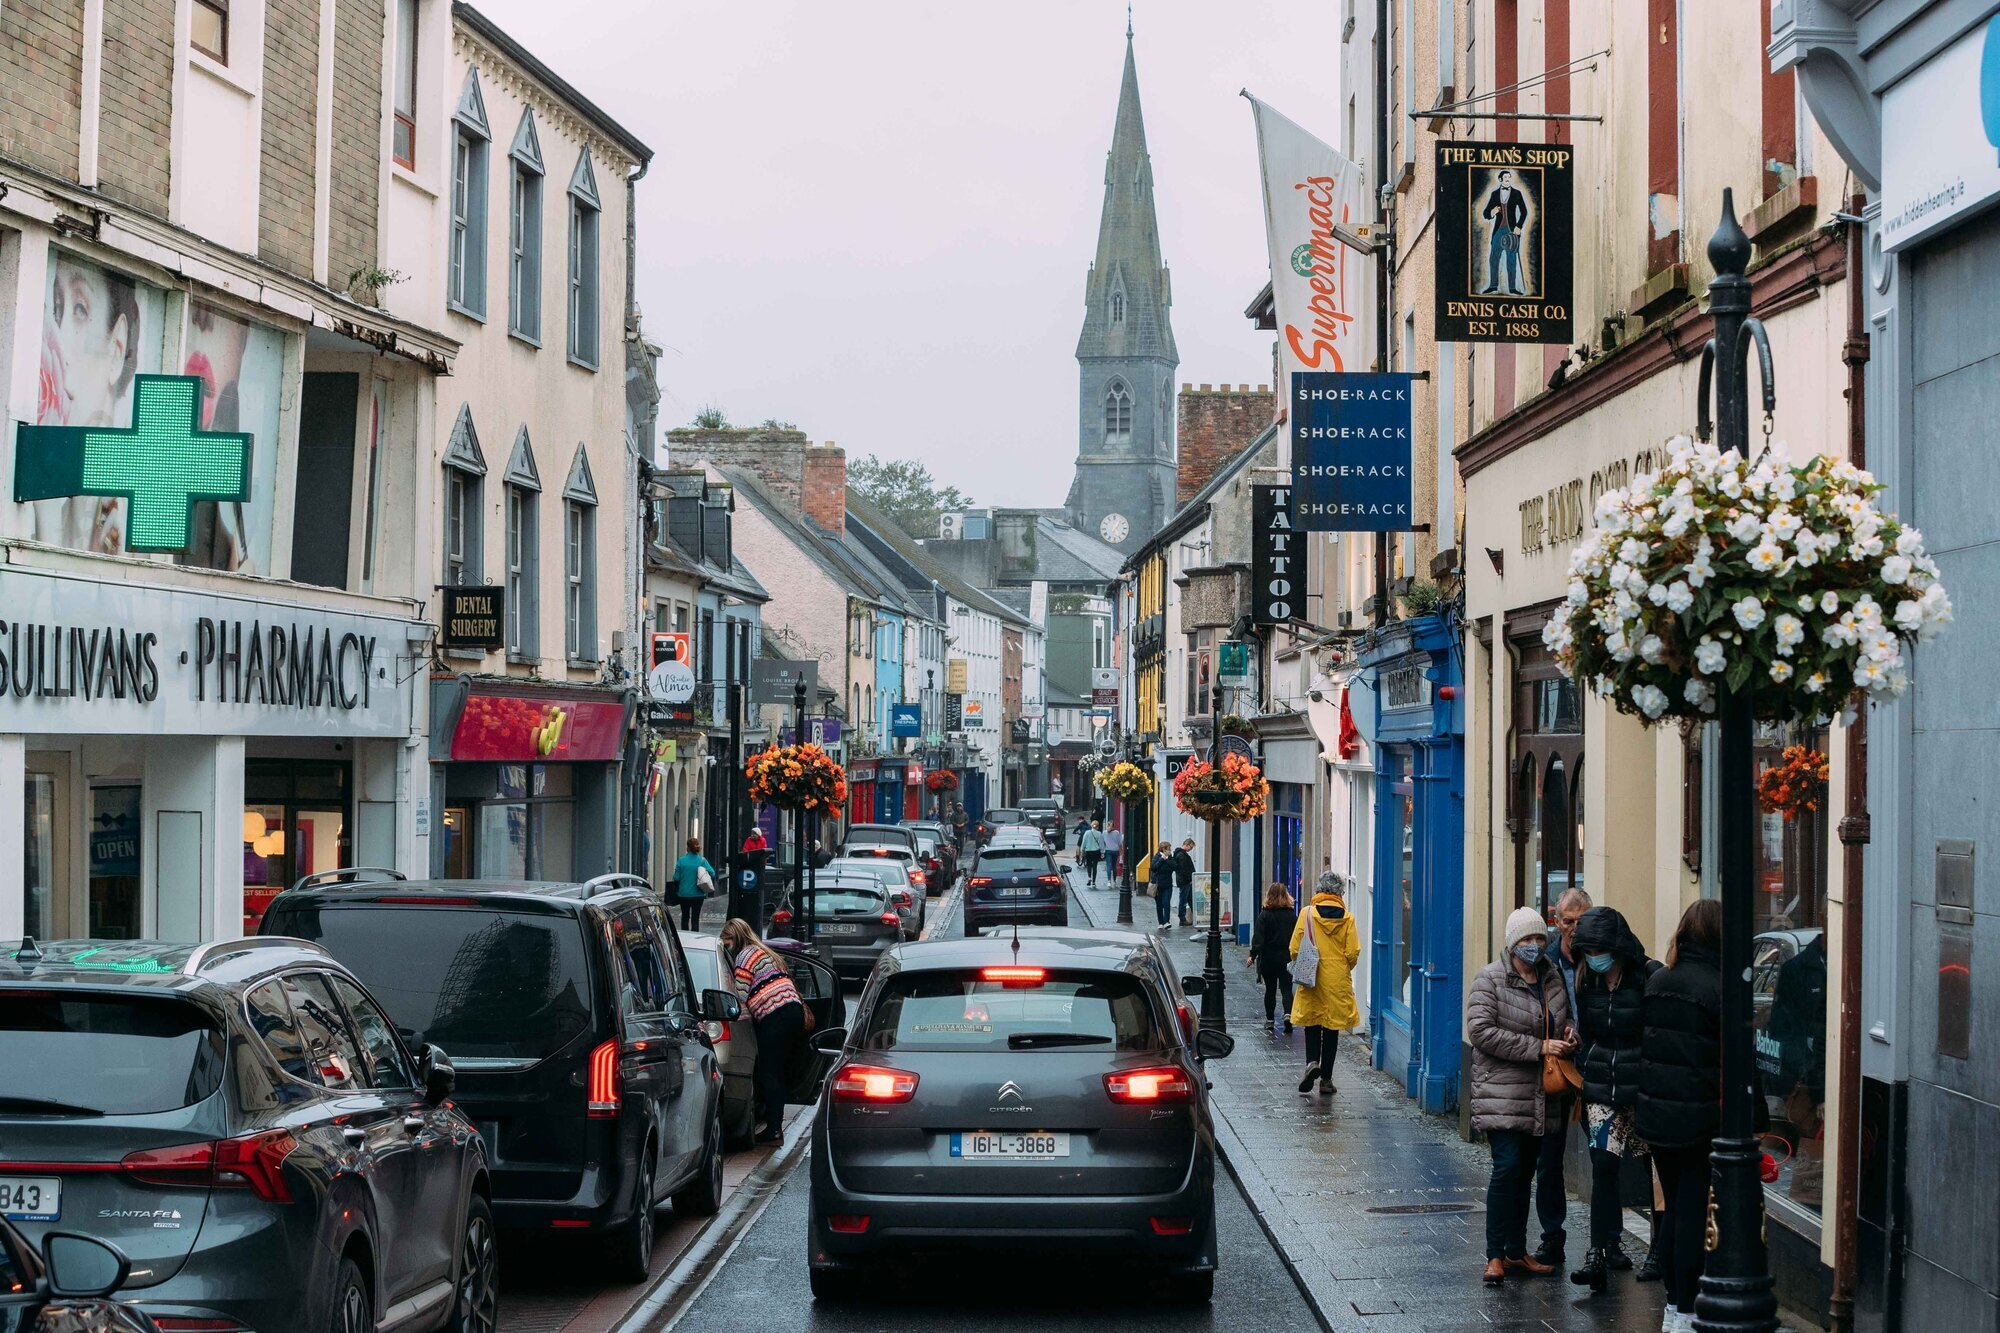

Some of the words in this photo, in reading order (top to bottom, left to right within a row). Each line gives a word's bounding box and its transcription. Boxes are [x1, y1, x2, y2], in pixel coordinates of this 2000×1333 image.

[1441, 148, 1475, 165] THE
[1481, 147, 1522, 164] MAN'S
[1527, 150, 1570, 168] SHOP
[1883, 176, 1965, 235] www.hiddenhearing.ie
[1286, 176, 1353, 372] Supermac's
[1447, 302, 1494, 317] ENNIS
[1499, 304, 1538, 319] CASH
[1544, 306, 1567, 320] CO.
[1469, 321, 1499, 336] EST.
[1505, 323, 1539, 337] 1888
[1269, 489, 1291, 619] TATTOO
[456, 596, 493, 615] DENTAL
[450, 619, 497, 637] SURGERY
[0, 618, 158, 704] SULLIVANS
[198, 617, 377, 710] PHARMACY
[651, 674, 693, 693] Alma
[97, 840, 135, 860] OPEN
[1756, 1028, 1780, 1059] Barbour
[973, 1136, 1056, 1154] 161-L-3868
[97, 1209, 150, 1218] SANTA
[151, 1210, 171, 1219] FE
